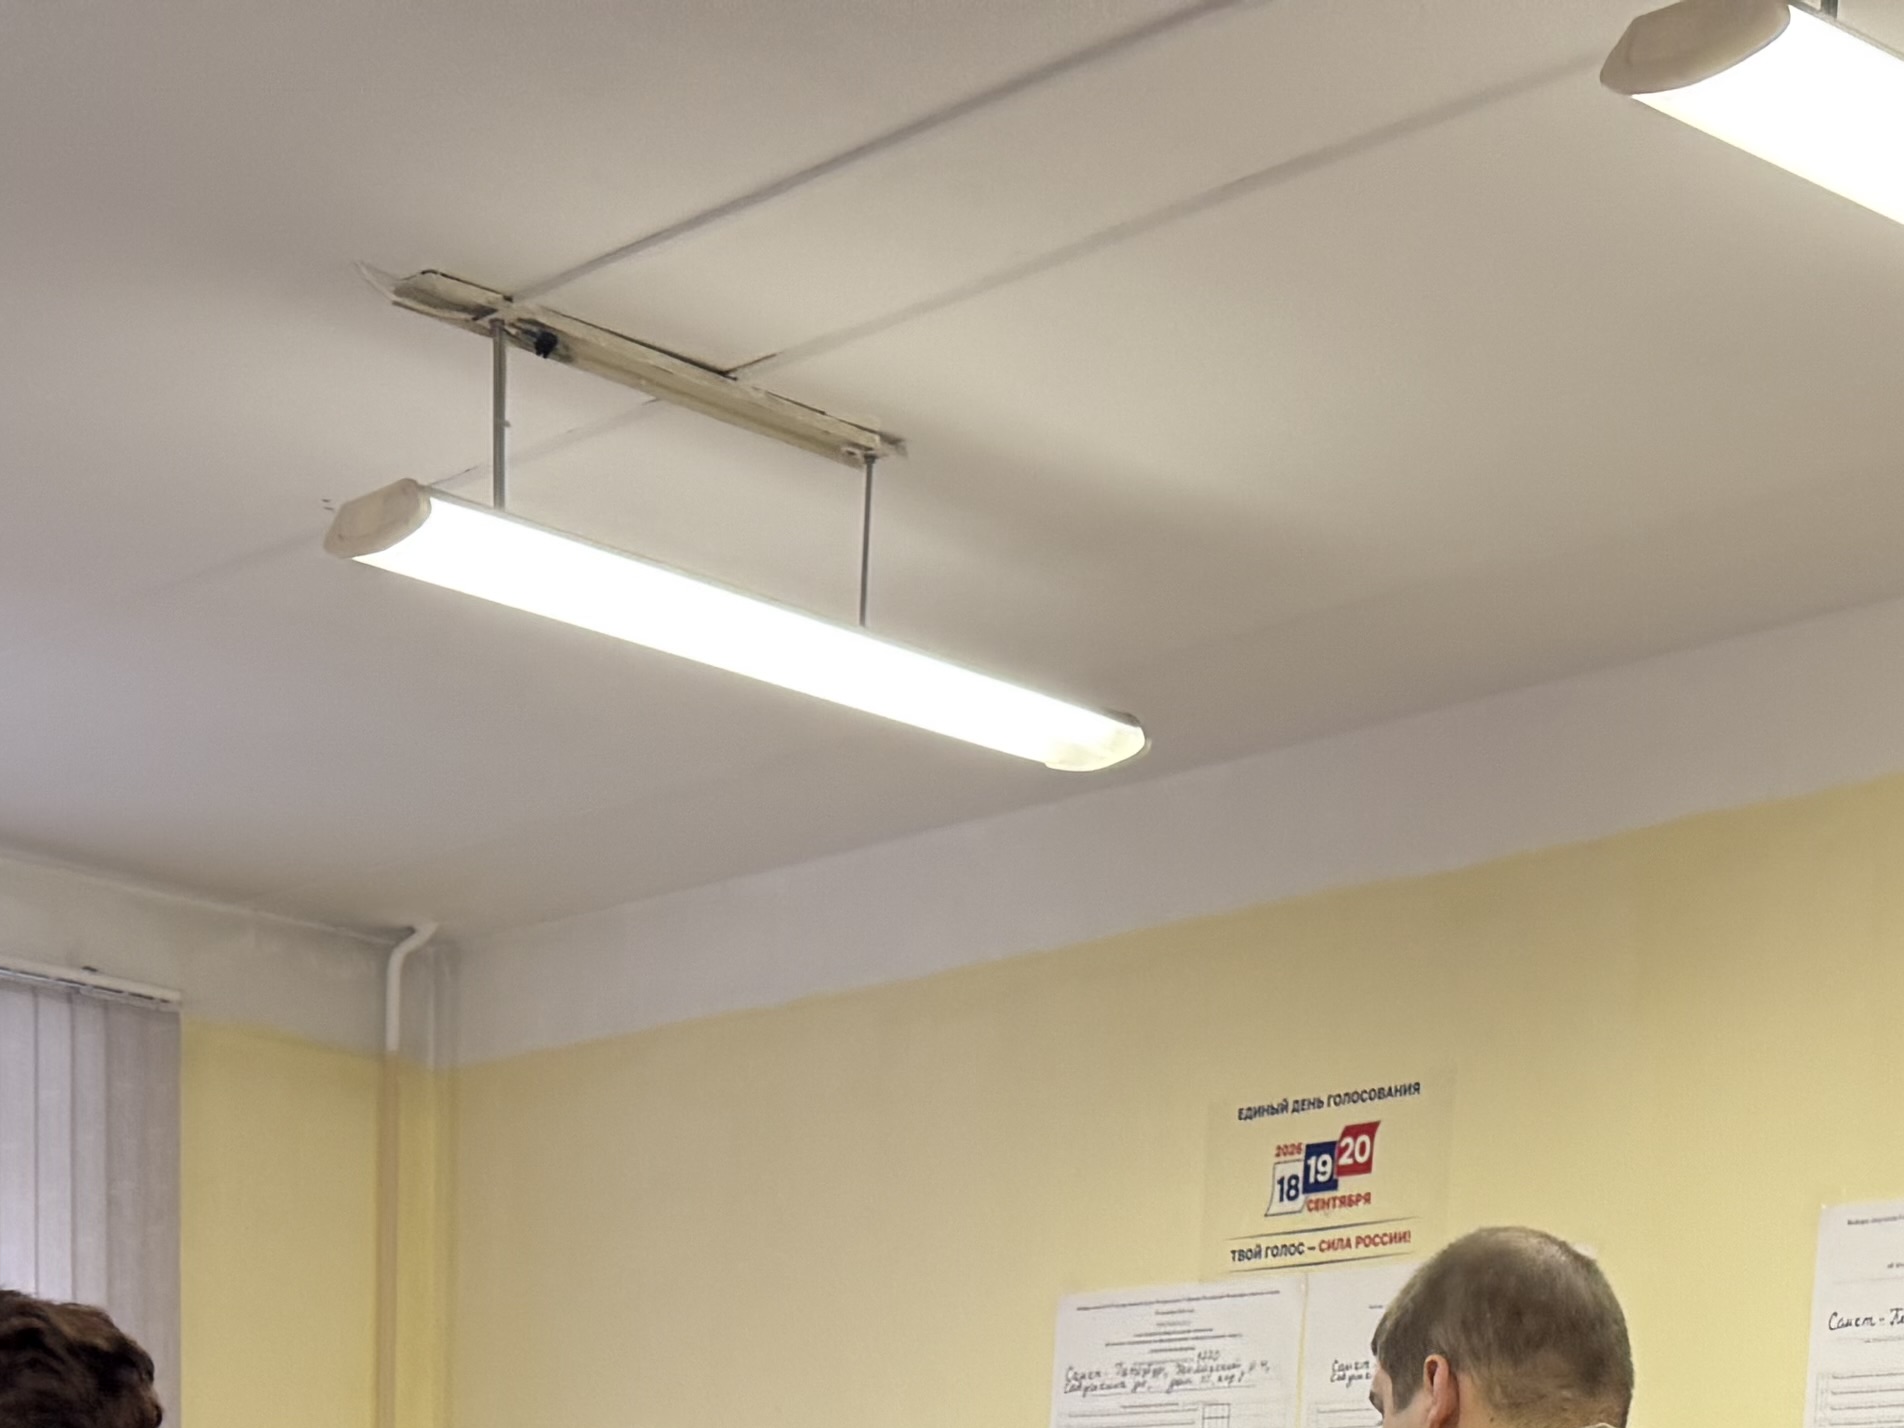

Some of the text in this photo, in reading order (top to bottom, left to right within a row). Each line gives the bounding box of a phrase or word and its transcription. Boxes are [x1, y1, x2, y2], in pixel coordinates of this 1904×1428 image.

[1237, 1082, 1421, 1121] ЕДИНЫЙ ДЕНЬ ГОЛОСОВАНИЯ
[1277, 1134, 1371, 1202] 18 19 20
[1306, 1192, 1372, 1213] СЕНТЯБРЯ
[1230, 1244, 1263, 1262] ТВОЙ
[1265, 1242, 1305, 1258] ГОЛОС
[1318, 1238, 1352, 1253] СИЛА
[1355, 1230, 1412, 1250] РОССИИ!
